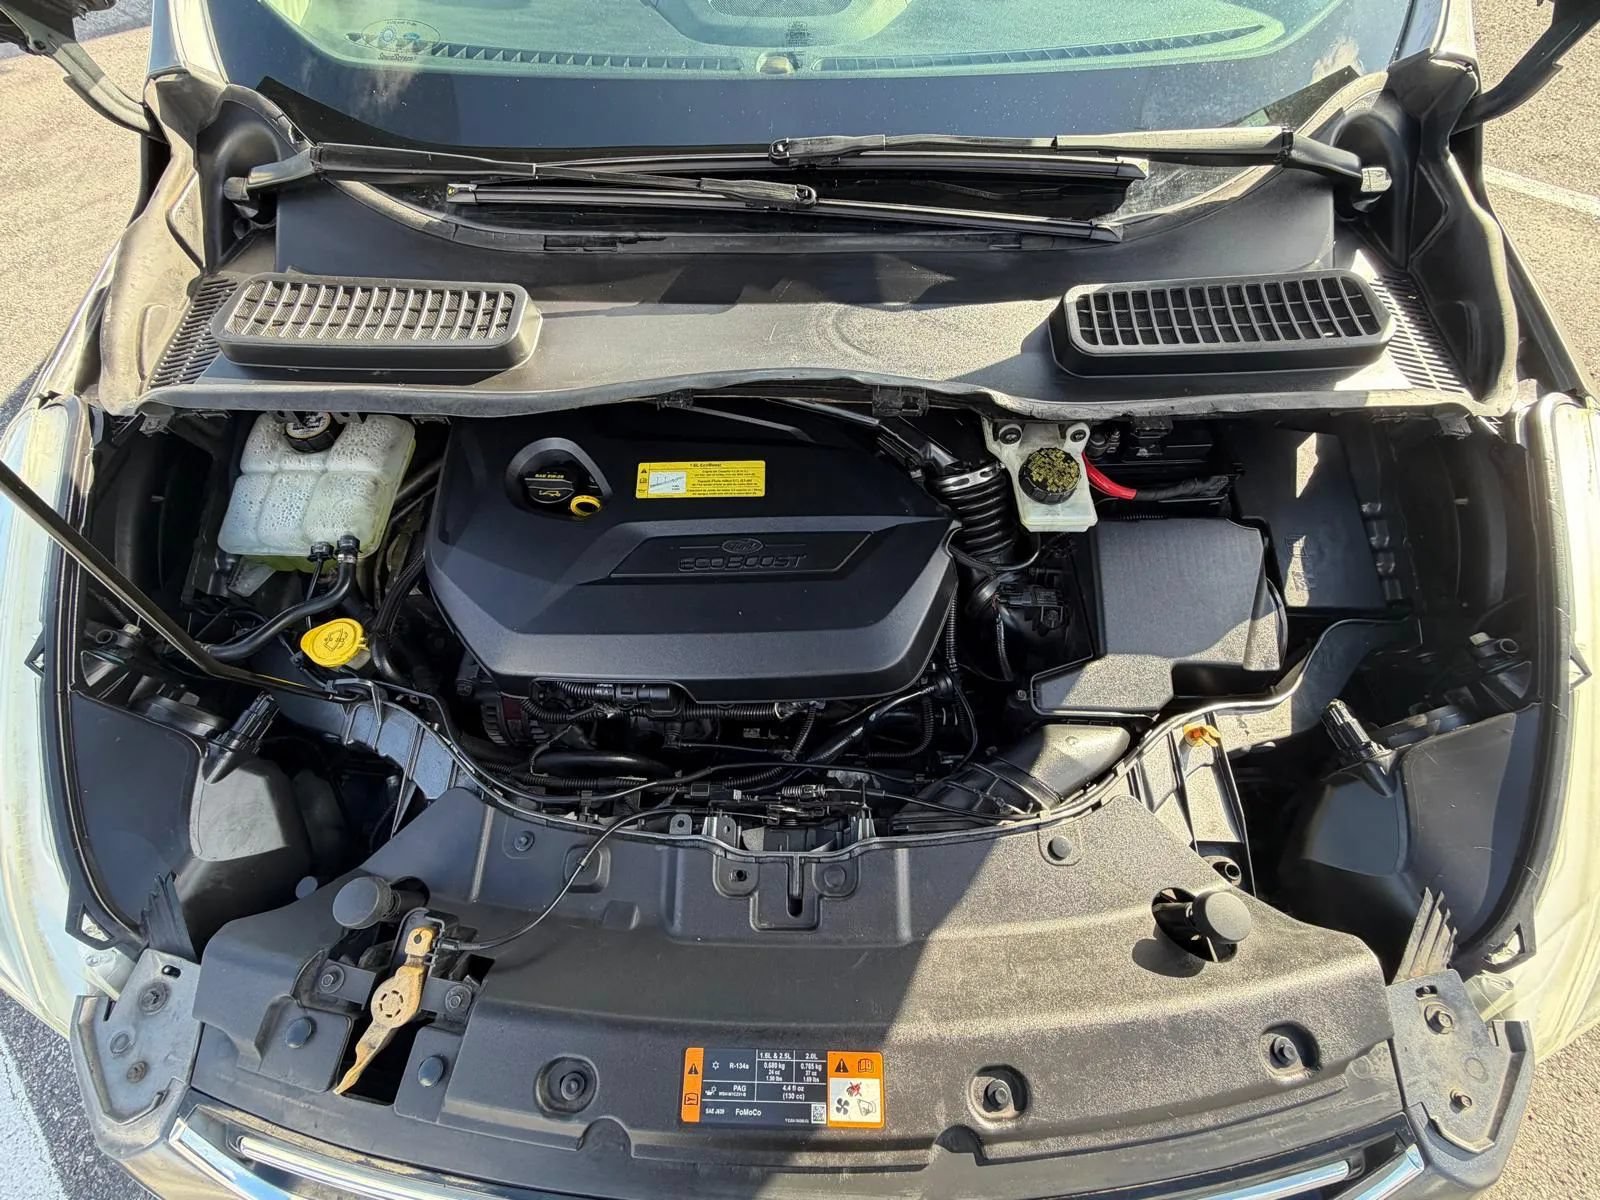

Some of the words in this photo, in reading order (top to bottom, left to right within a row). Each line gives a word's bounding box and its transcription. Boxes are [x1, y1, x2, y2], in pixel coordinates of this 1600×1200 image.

[729, 1062, 750, 1070] R-134a
[778, 1062, 786, 1071] kg
[815, 1063, 822, 1071] kg
[733, 1084, 746, 1092] PAG
[796, 1093, 805, 1101] cc)
[735, 1108, 762, 1117] FoMoCo
